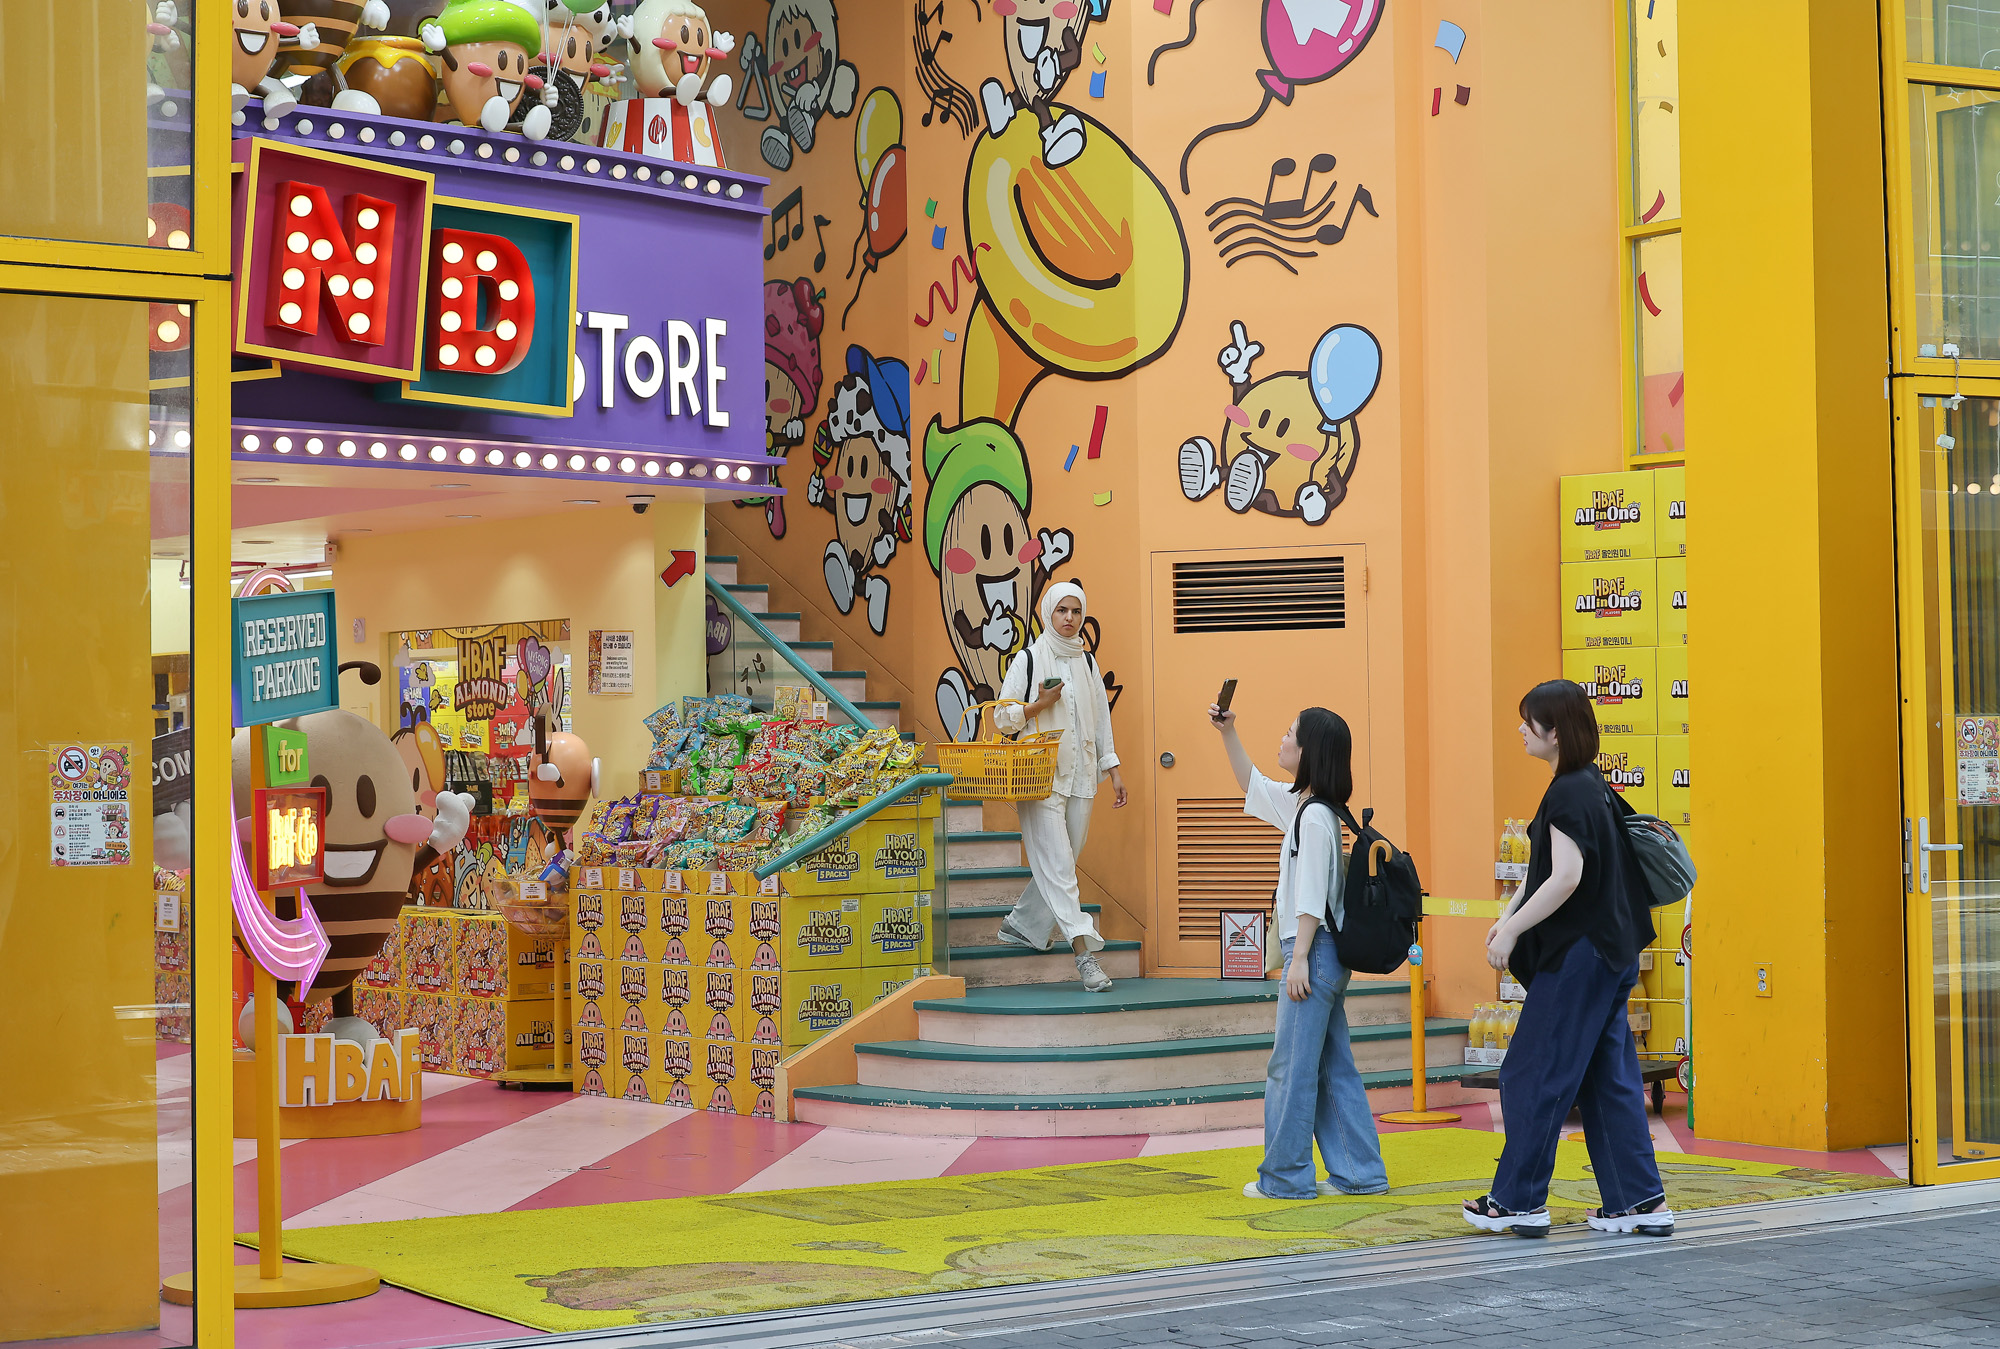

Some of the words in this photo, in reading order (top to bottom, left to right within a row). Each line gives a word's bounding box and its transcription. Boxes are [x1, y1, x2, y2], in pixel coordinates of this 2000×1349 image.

[1592, 489, 1624, 509] HBAF
[1594, 577, 1624, 596] HBAF
[242, 612, 326, 657] RESERVED
[457, 636, 506, 682] HBAF
[527, 651, 549, 670] MYEONG
[529, 664, 543, 677] DONG
[1594, 665, 1625, 683] HBAF
[252, 657, 320, 702] PARKING
[455, 680, 508, 708] ALMOND
[466, 701, 496, 719] store
[278, 740, 303, 772] for
[1597, 752, 1627, 771] HBAF
[54, 791, 90, 800] 주차장이
[93, 790, 127, 800] 아니에요
[886, 834, 914, 849] HBAF
[808, 853, 824, 863] ALL
[828, 854, 858, 864] YOUR
[877, 850, 892, 860] ALL
[894, 850, 922, 860] YOUR
[807, 862, 832, 870] FAVORITE
[580, 894, 601, 912] HBAF
[623, 896, 646, 913] HBAF
[664, 899, 688, 916] HBAF
[708, 900, 732, 918] HBAF
[578, 912, 603, 923] ALMOND
[752, 902, 777, 920] HBAF
[884, 908, 911, 923] HBAF
[621, 913, 646, 925] ALMOND
[662, 916, 689, 928] ALMOND
[705, 918, 733, 930] ALMOND
[750, 920, 780, 932] ALMOND
[810, 912, 840, 926] HBAF
[800, 927, 817, 937] ALL
[819, 927, 849, 938] YOUR
[873, 924, 890, 934] ALL
[891, 924, 920, 934] YOUR
[534, 940, 554, 953] HBA
[817, 944, 840, 952] PACKS
[581, 964, 602, 980] HBAF
[623, 966, 645, 984] HBAF
[665, 969, 688, 987] HBAF
[578, 980, 604, 991] ALMOND
[621, 983, 647, 995] ALMOND
[709, 973, 732, 990] HBAF
[754, 976, 778, 994] HBAF
[662, 987, 689, 998] ALMOND
[706, 991, 734, 1002] ALMOND
[752, 994, 780, 1006] ALMOND
[810, 985, 840, 1000] HBAF
[800, 1001, 817, 1011] ALL
[820, 1001, 849, 1012] YOUR
[825, 1010, 850, 1018] FLAVORS!
[532, 1021, 554, 1034] HBA
[812, 1019, 817, 1027] 5
[583, 1032, 603, 1048] HBAF
[625, 1036, 647, 1053] HBAF
[581, 1049, 606, 1060] ALMOND
[667, 1040, 689, 1057] HBAF
[710, 1045, 733, 1063] HBAF
[623, 1054, 649, 1065] ALMOND
[665, 1058, 692, 1070] ALMOND
[754, 1049, 778, 1068] HBAF
[278, 1028, 421, 1107] HBAF
[708, 1064, 734, 1075] ALMOND
[759, 1078, 774, 1086] store
